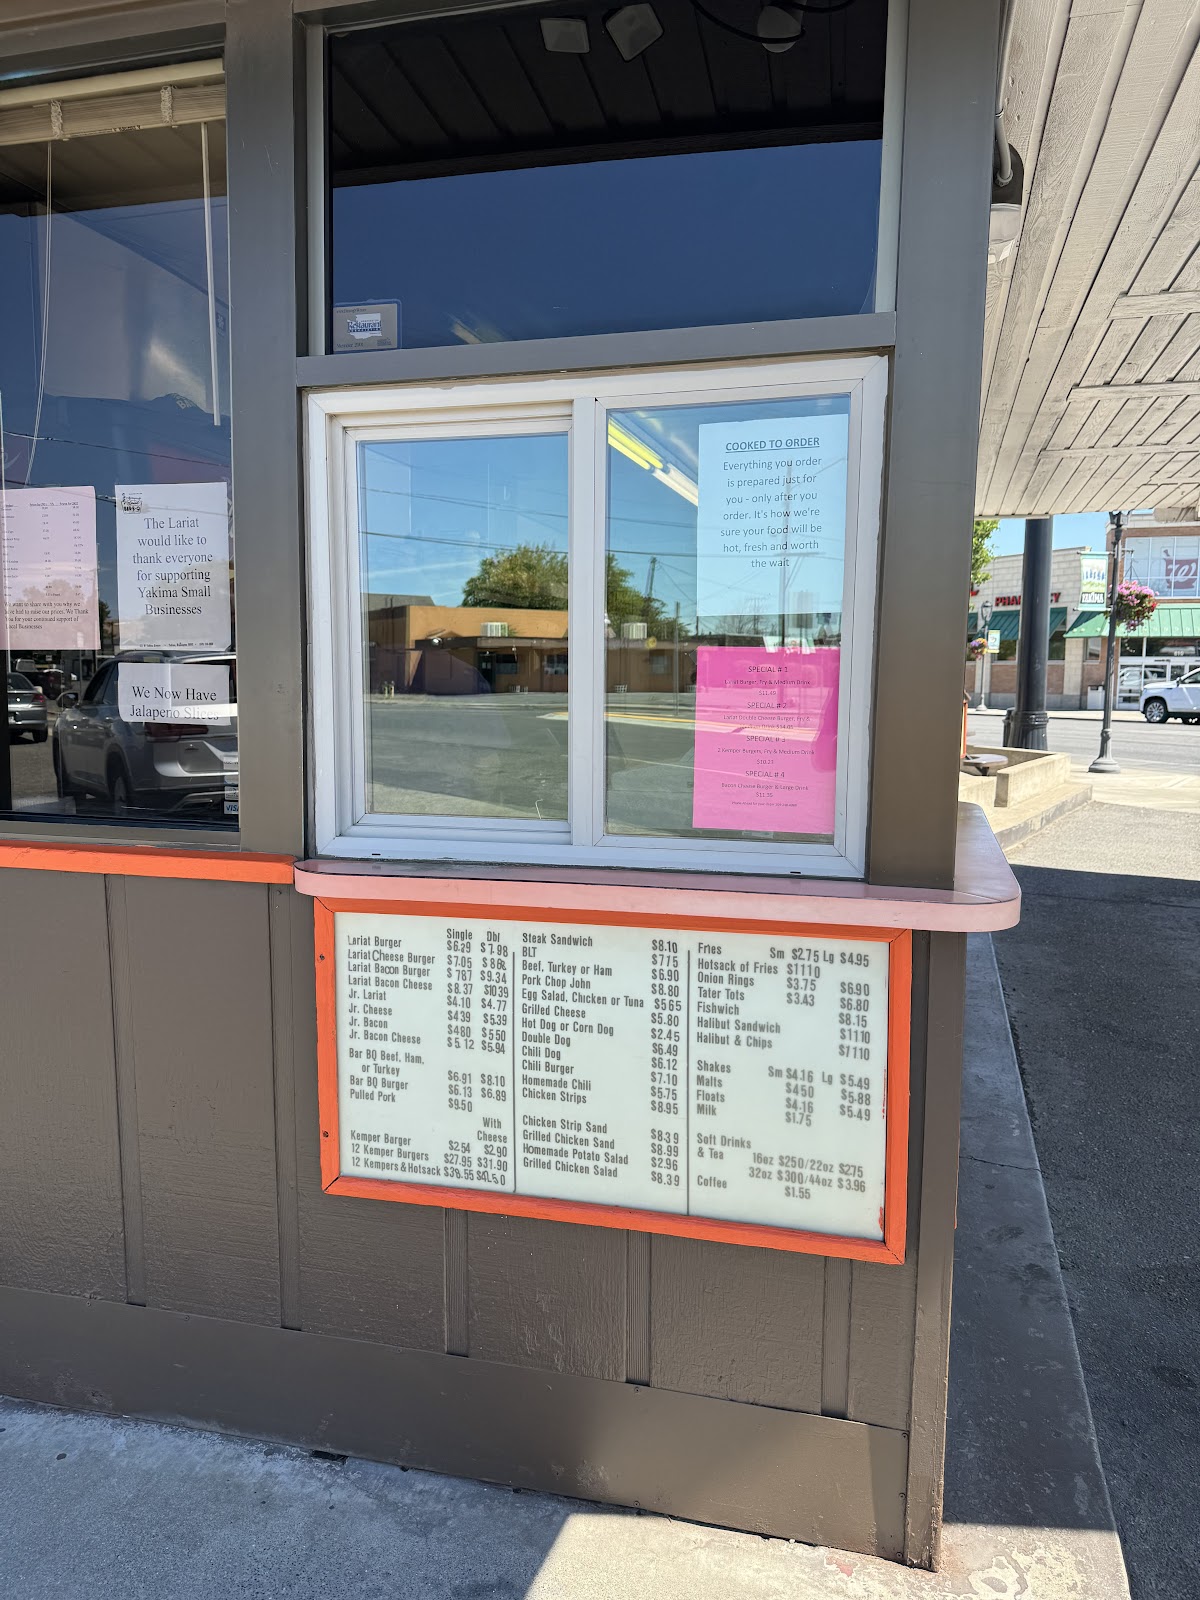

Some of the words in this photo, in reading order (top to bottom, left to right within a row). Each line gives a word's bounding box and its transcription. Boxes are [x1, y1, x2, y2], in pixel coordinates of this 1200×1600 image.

[726, 441, 766, 451] COOKED
[769, 440, 782, 448] TO
[786, 437, 820, 447] ORDER
[723, 460, 772, 471] Everything
[775, 461, 792, 469] you
[796, 457, 822, 466] order
[728, 479, 734, 487] is
[738, 476, 780, 488] prepared
[782, 476, 800, 486] just
[803, 474, 816, 483] for
[726, 497, 743, 505] you
[752, 494, 771, 504] only
[775, 493, 797, 502] after
[800, 493, 817, 501] you
[723, 512, 751, 520] order.
[754, 510, 767, 519] It's
[771, 509, 790, 518] how
[794, 508, 820, 517] we're
[144, 518, 165, 529] The
[169, 517, 199, 528] Lariat
[743, 528, 764, 537] your
[767, 526, 789, 535] food
[791, 524, 808, 533] will
[811, 524, 822, 532] be
[138, 538, 171, 546] would
[175, 535, 193, 545] like
[197, 536, 206, 545] to
[723, 544, 741, 553] hot,
[744, 543, 767, 552] fresh
[771, 542, 787, 551] and
[791, 540, 819, 549] worth
[133, 553, 162, 563] thank
[166, 554, 213, 565] everyone
[751, 559, 766, 568] the
[769, 558, 789, 567] wait
[137, 570, 152, 580] for
[155, 569, 210, 583] supporting
[138, 587, 178, 598] Yakima
[182, 586, 211, 597] Small
[145, 604, 202, 615] Businesses
[132, 686, 150, 698] We
[154, 687, 181, 699] Now
[186, 688, 217, 700] Have
[184, 707, 219, 721] Slices
[447, 929, 472, 940] Single
[487, 931, 500, 942] Dbl
[522, 933, 546, 944] Steak
[551, 934, 593, 947] Sandwich
[652, 940, 677, 953] $8.10
[522, 947, 537, 957] BLT
[698, 958, 735, 971] Hotsack
[740, 961, 749, 972] of
[754, 962, 778, 974] Fries
[348, 975, 371, 986] Lariat
[375, 977, 399, 988] Bacon
[403, 979, 432, 990] Cheese
[448, 983, 472, 995] $8.37
[522, 974, 541, 985] Pork
[545, 976, 566, 988] Chop
[570, 978, 590, 989] John
[651, 984, 679, 997] $8.80
[698, 972, 723, 984] Onion
[728, 974, 754, 987] Rings
[787, 978, 816, 991] $3.75
[840, 982, 869, 996] $6.90
[349, 989, 359, 999] Jr.
[363, 989, 386, 1000] Lariat
[447, 995, 470, 1009] $4.10
[481, 998, 507, 1011] $4.77
[698, 987, 721, 999] Tater
[725, 988, 745, 1000] Tots
[787, 992, 815, 1007] $3.43
[840, 998, 869, 1012] $6.80
[522, 1003, 550, 1015] Grilled
[555, 1006, 585, 1018] Cheese
[651, 1013, 679, 1027] $5.80
[698, 1002, 739, 1015] Fishwich
[839, 1013, 867, 1028] $8.15
[522, 1032, 550, 1043] Double
[555, 1034, 571, 1047] Dog
[652, 1043, 678, 1056] $6.49
[522, 1060, 541, 1072] Chili
[545, 1062, 574, 1075] Burger
[651, 1072, 677, 1086] $7.10
[697, 1060, 731, 1073] Shakes
[768, 1066, 782, 1078] Sm
[786, 1068, 813, 1083] $4.16
[822, 1072, 832, 1085] Lg
[840, 1074, 869, 1090] $5.49
[350, 1075, 363, 1086] Bar
[367, 1077, 377, 1088] BQ
[382, 1078, 408, 1090] Burger
[448, 1085, 472, 1098] $6.13
[481, 1088, 506, 1101] $6.89
[350, 1089, 374, 1100] Pulled
[378, 1091, 396, 1102] Pork
[448, 1098, 472, 1112] $9.50
[697, 1104, 717, 1116] Milk
[785, 1112, 811, 1127] $1.75
[697, 1133, 716, 1145] Soft
[721, 1135, 751, 1149] Drinks
[352, 1144, 360, 1153] 12
[363, 1144, 393, 1157] Kemper
[397, 1148, 429, 1161] Burgers
[444, 1153, 472, 1167] $27.95
[477, 1157, 507, 1172] $31.90
[523, 1144, 568, 1158] Homemade
[573, 1149, 600, 1161] Potato
[604, 1152, 628, 1164] Salad
[651, 1157, 678, 1171] $2.96
[698, 1147, 704, 1158] &
[709, 1148, 723, 1160] Tea
[697, 1175, 727, 1189] Coffee
[785, 1186, 811, 1199] $1.55
